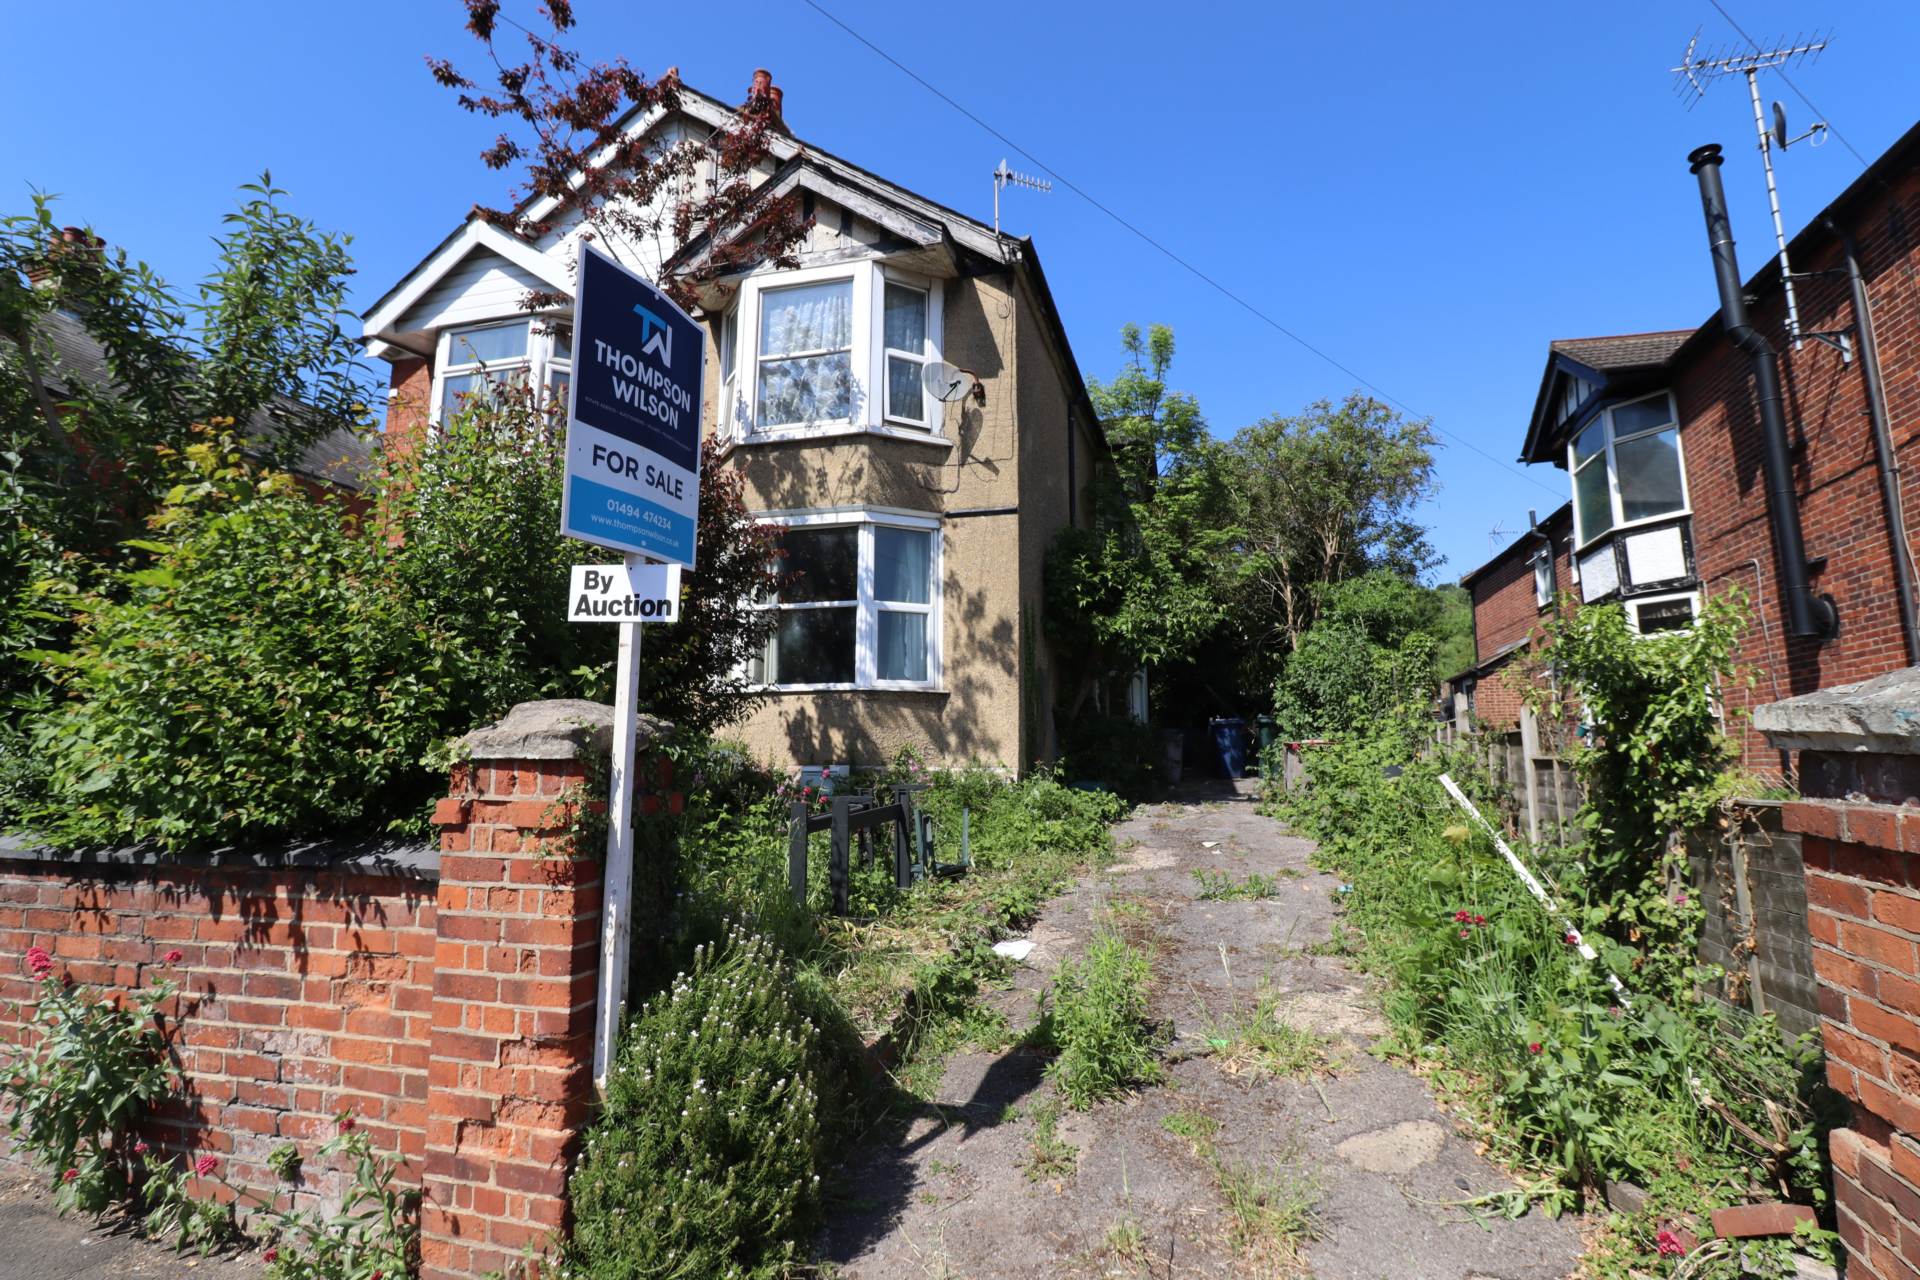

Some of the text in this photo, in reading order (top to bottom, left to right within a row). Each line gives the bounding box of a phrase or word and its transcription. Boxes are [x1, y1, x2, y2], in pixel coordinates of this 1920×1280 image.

[594, 338, 691, 413] THOMPSON
[612, 375, 679, 430] WILSON
[592, 444, 683, 500] FOR SALE
[607, 499, 672, 531] 01494 474234
[584, 570, 614, 594] By
[574, 594, 672, 616] Auction
